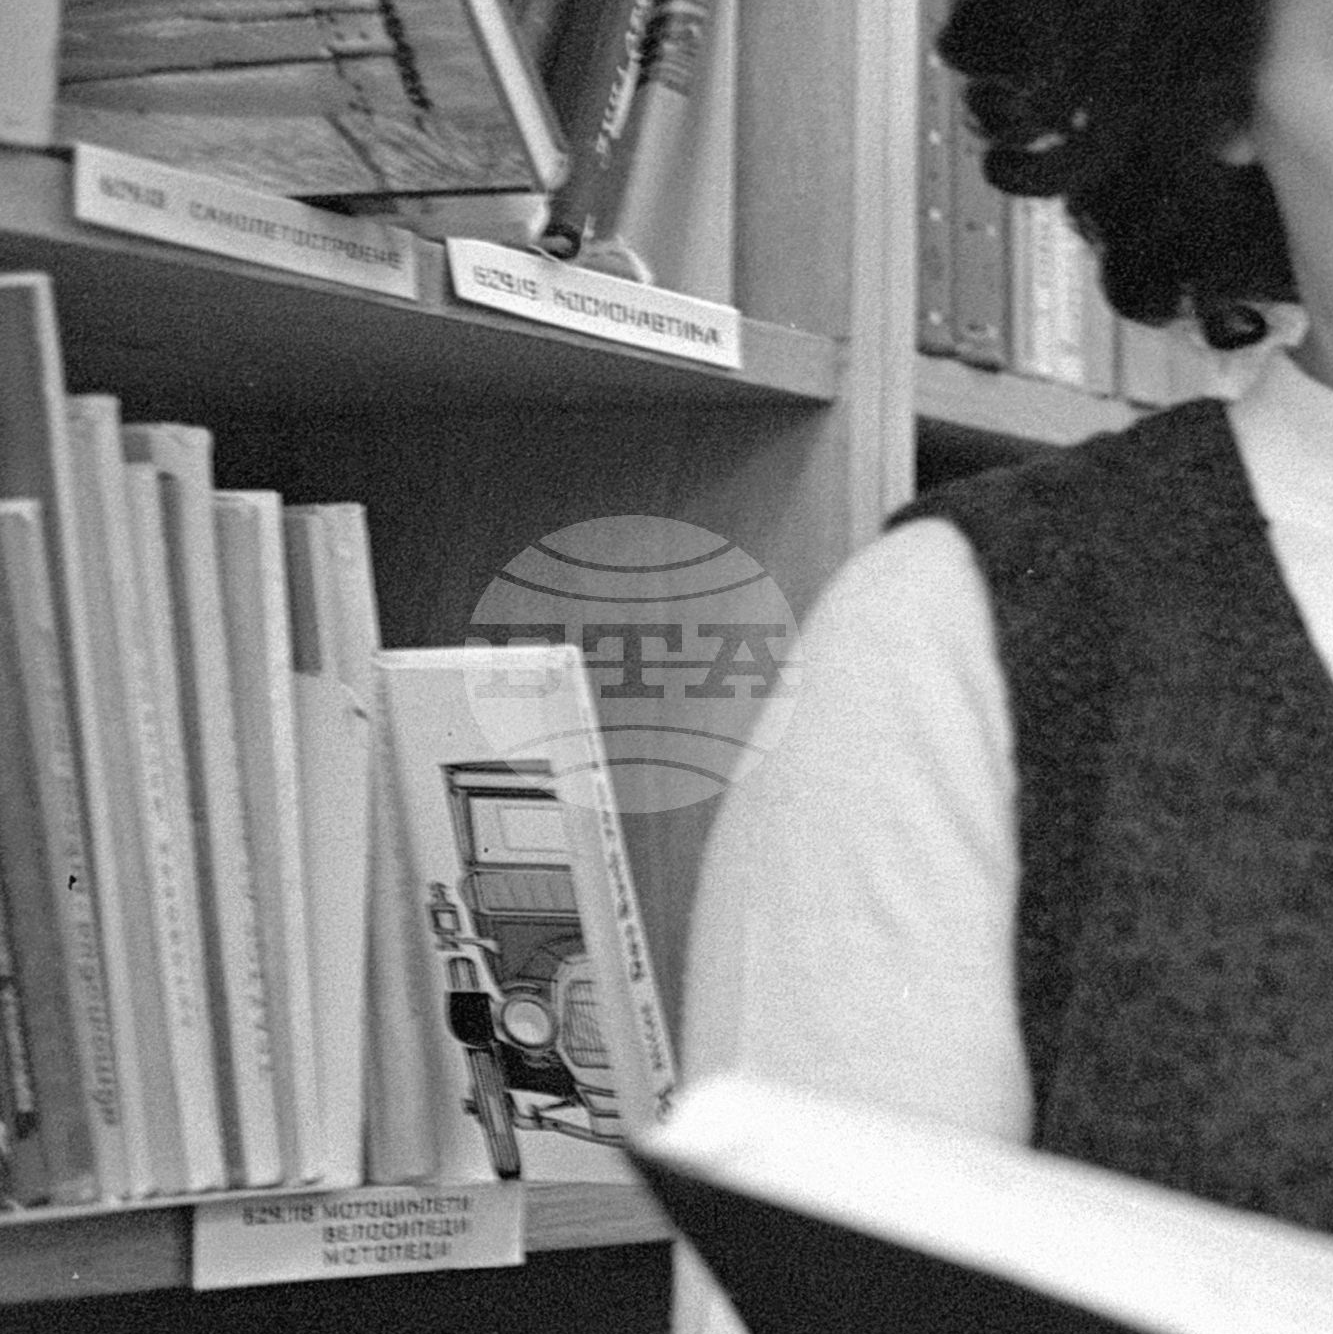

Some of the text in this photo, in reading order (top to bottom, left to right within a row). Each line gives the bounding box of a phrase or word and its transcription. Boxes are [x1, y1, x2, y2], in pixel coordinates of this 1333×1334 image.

[552, 287, 720, 346] КОСМОНАВТИКА
[321, 1195, 470, 1220] МОТОЦИКЛЕТИ
[322, 1217, 468, 1243] ВЕЛОСИПЕДИ
[322, 1240, 450, 1266] МОТОПЕДИ
